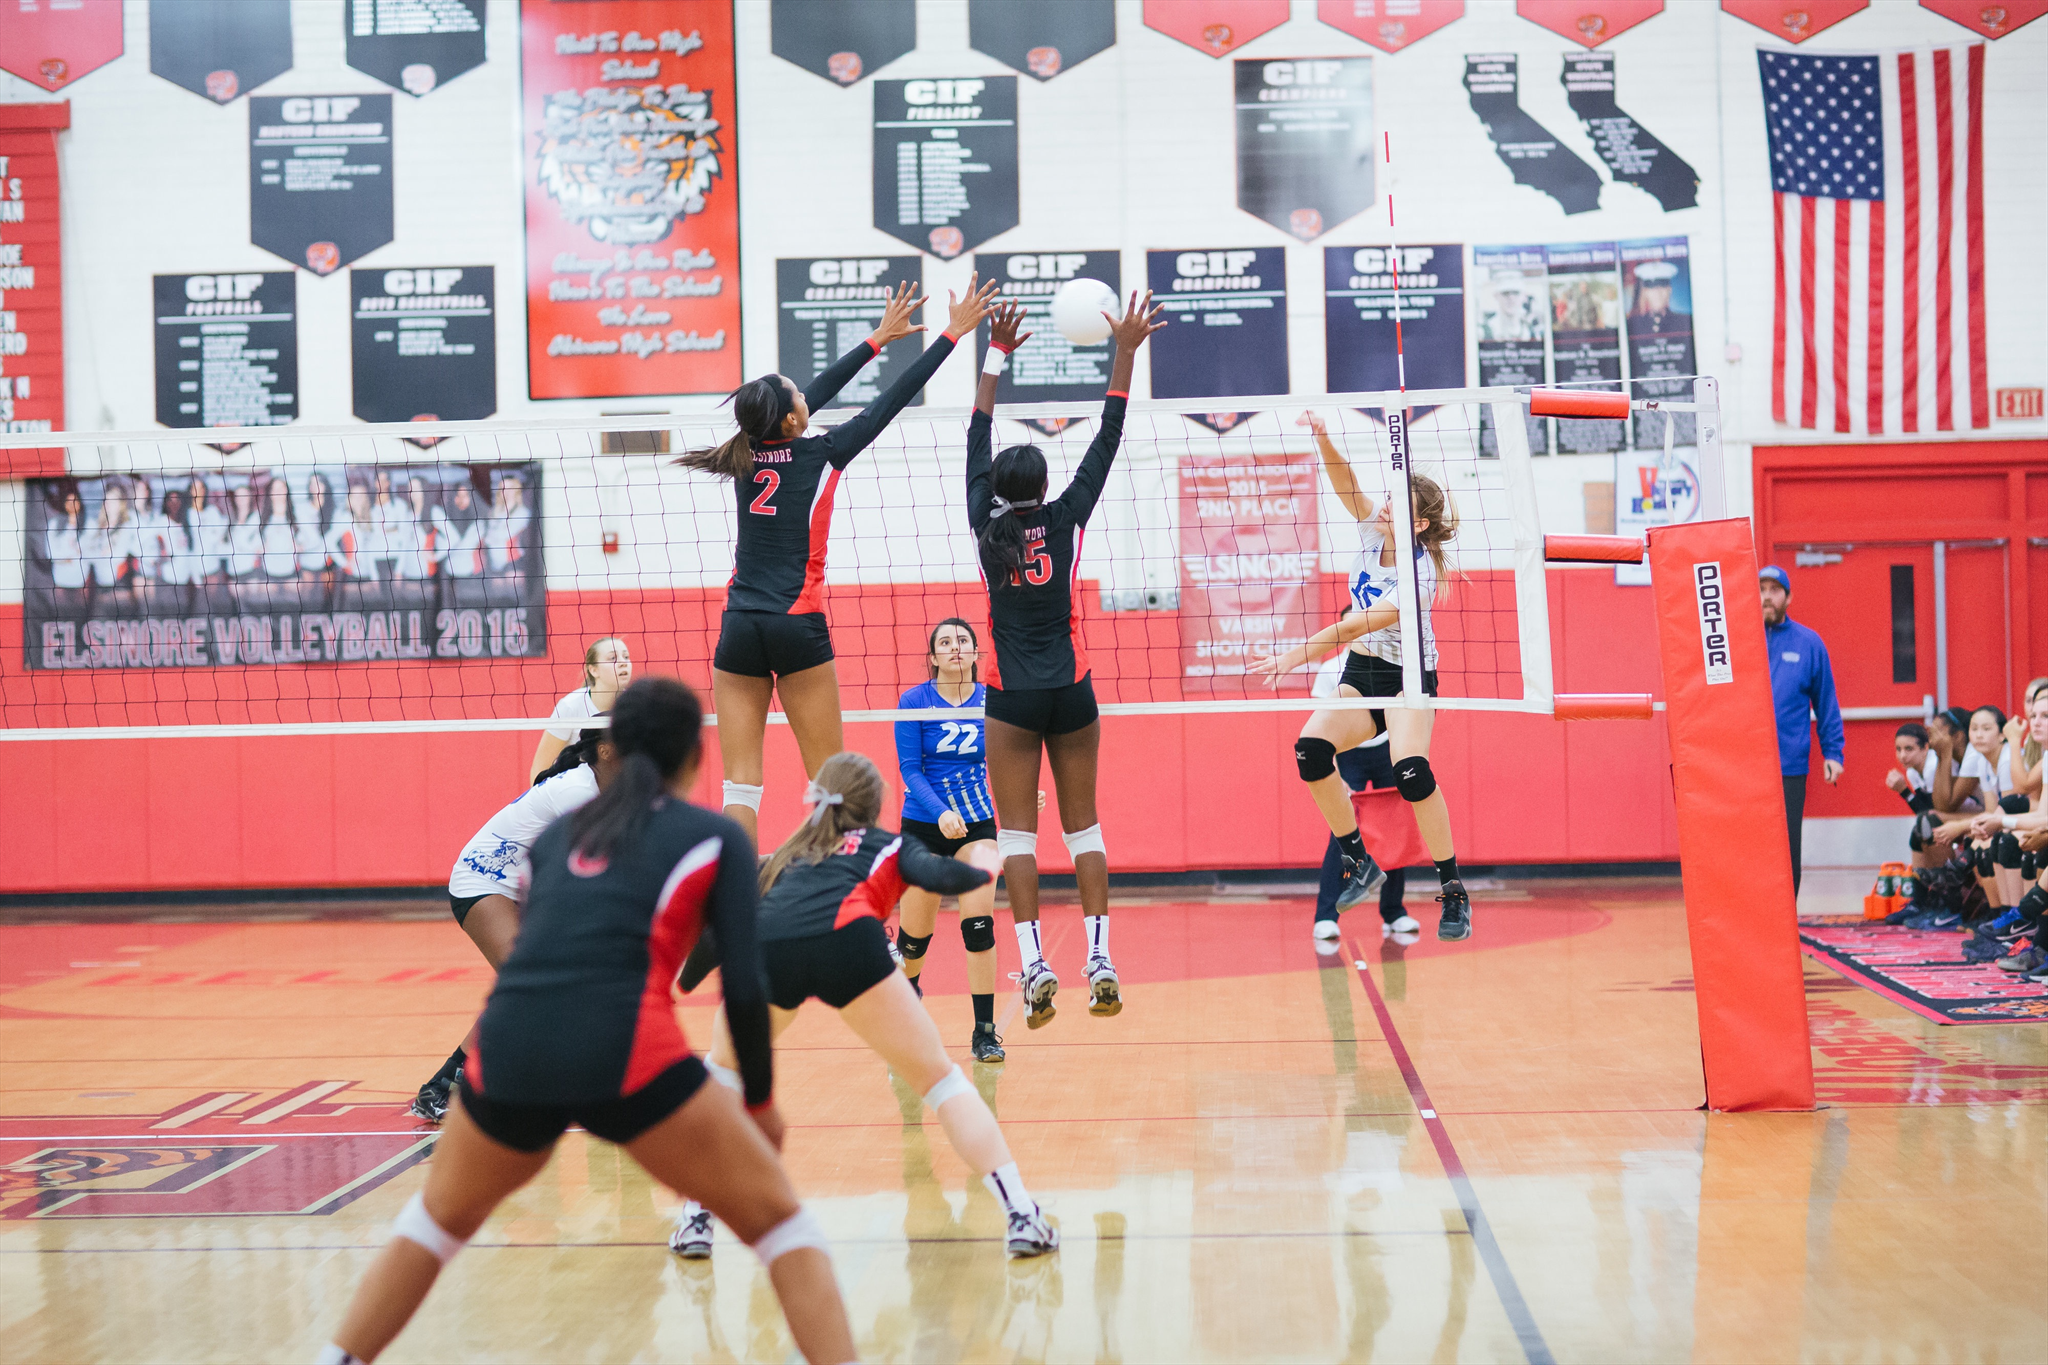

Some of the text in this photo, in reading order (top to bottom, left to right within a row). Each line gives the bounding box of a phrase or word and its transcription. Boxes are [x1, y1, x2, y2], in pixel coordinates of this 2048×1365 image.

[1263, 62, 1343, 86] CIF
[905, 80, 985, 105] CIF
[282, 97, 361, 123] CIF
[906, 106, 982, 120] FINALIST
[809, 260, 889, 285] CIF
[1007, 254, 1087, 279] CIF
[1176, 251, 1256, 277] CIF
[1354, 248, 1434, 273] CIF
[185, 274, 264, 301] CIF
[384, 269, 463, 295] CIF
[1002, 282, 1062, 295] CHAMP
[1172, 276, 1261, 291] CHAMPIONS
[1349, 274, 1438, 289] CHAMIONS
[2001, 391, 2038, 417] EXIT
[751, 448, 793, 463] LSINORE
[1388, 415, 1403, 471] PORTER
[750, 469, 781, 516] 2
[1197, 498, 1300, 518] 2ND PLACE
[1182, 553, 1319, 581] ELSINORE
[1218, 616, 1287, 634] VARSITY
[1697, 565, 1727, 667] PORTER
[42, 608, 529, 668] ELSINORE VOLLEYBALL 2015
[1195, 639, 1250, 657] SHOW
[936, 722, 979, 755] 22
